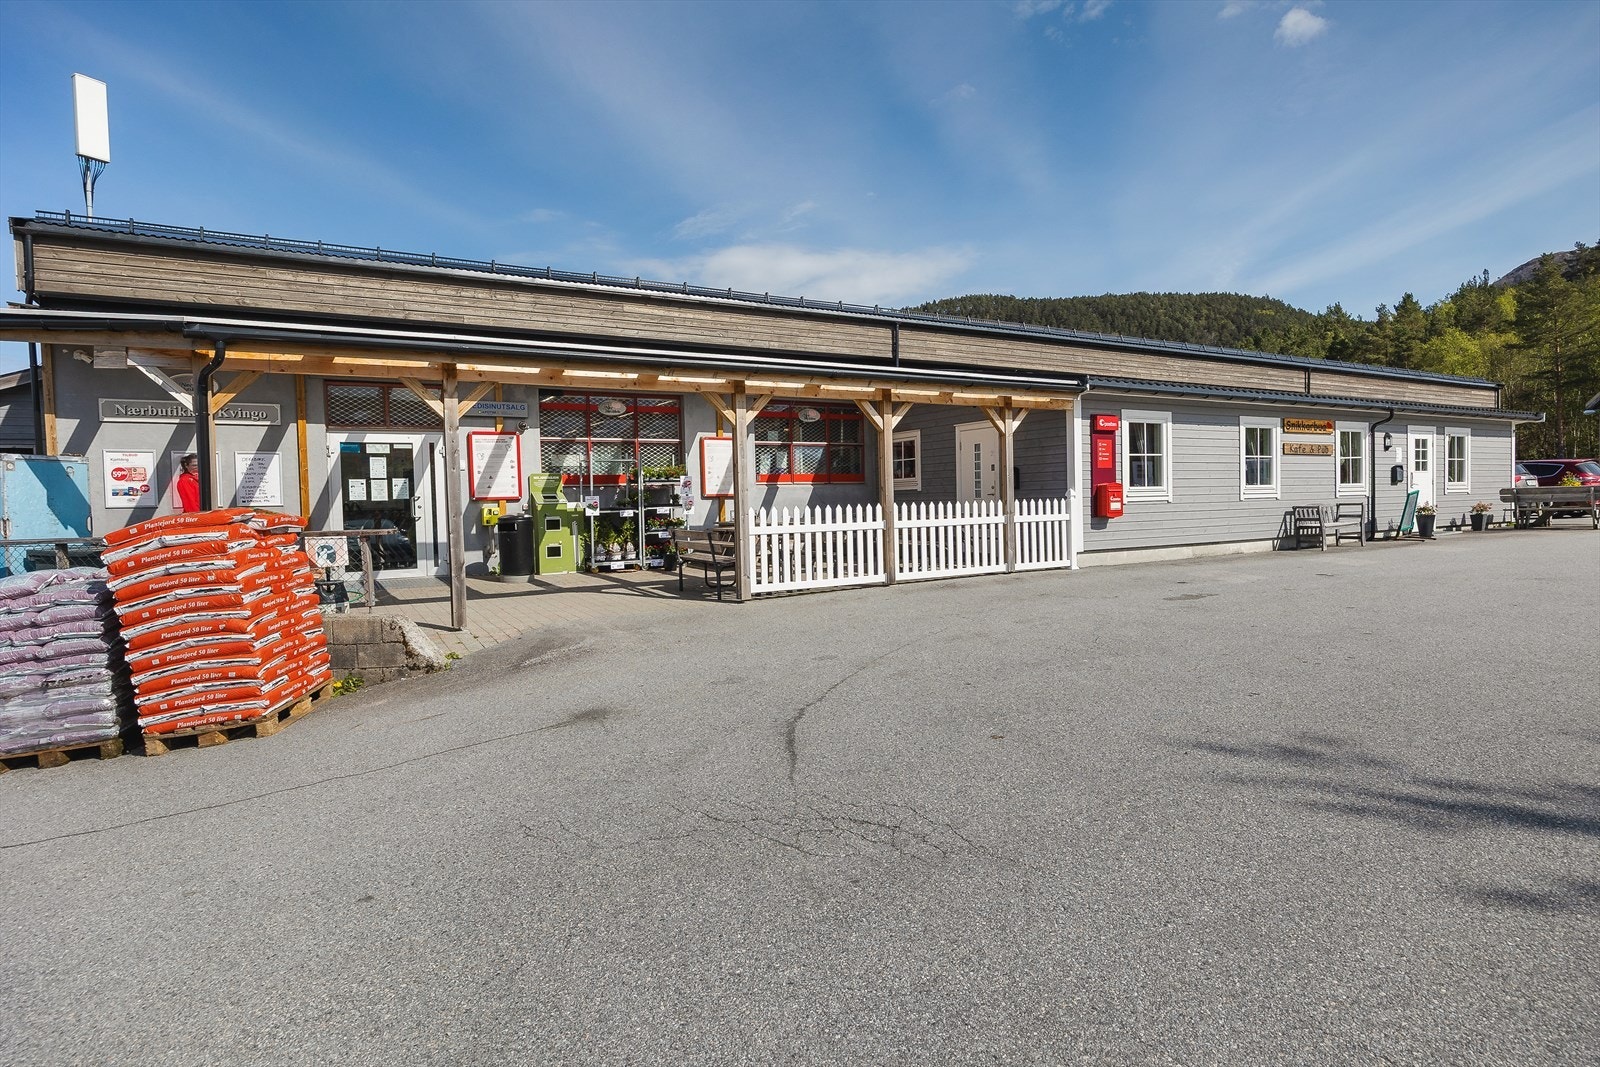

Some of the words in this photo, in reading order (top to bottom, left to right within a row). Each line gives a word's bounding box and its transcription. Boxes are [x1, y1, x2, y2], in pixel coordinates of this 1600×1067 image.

[114, 404, 196, 417] Nærbutikk
[218, 408, 268, 421] Kvingo
[1310, 444, 1315, 453] &
[1318, 445, 1330, 454] Pub
[144, 518, 175, 530] Plantejord
[141, 550, 171, 563] Plantejord
[149, 579, 178, 590] Plantejord
[156, 603, 186, 614] Plantejord
[161, 628, 190, 639] Plantejord
[166, 651, 197, 661] Plantejord
[171, 675, 200, 685] Plantejord
[174, 696, 205, 706] Plantejord
[177, 718, 206, 728] Plantejord
